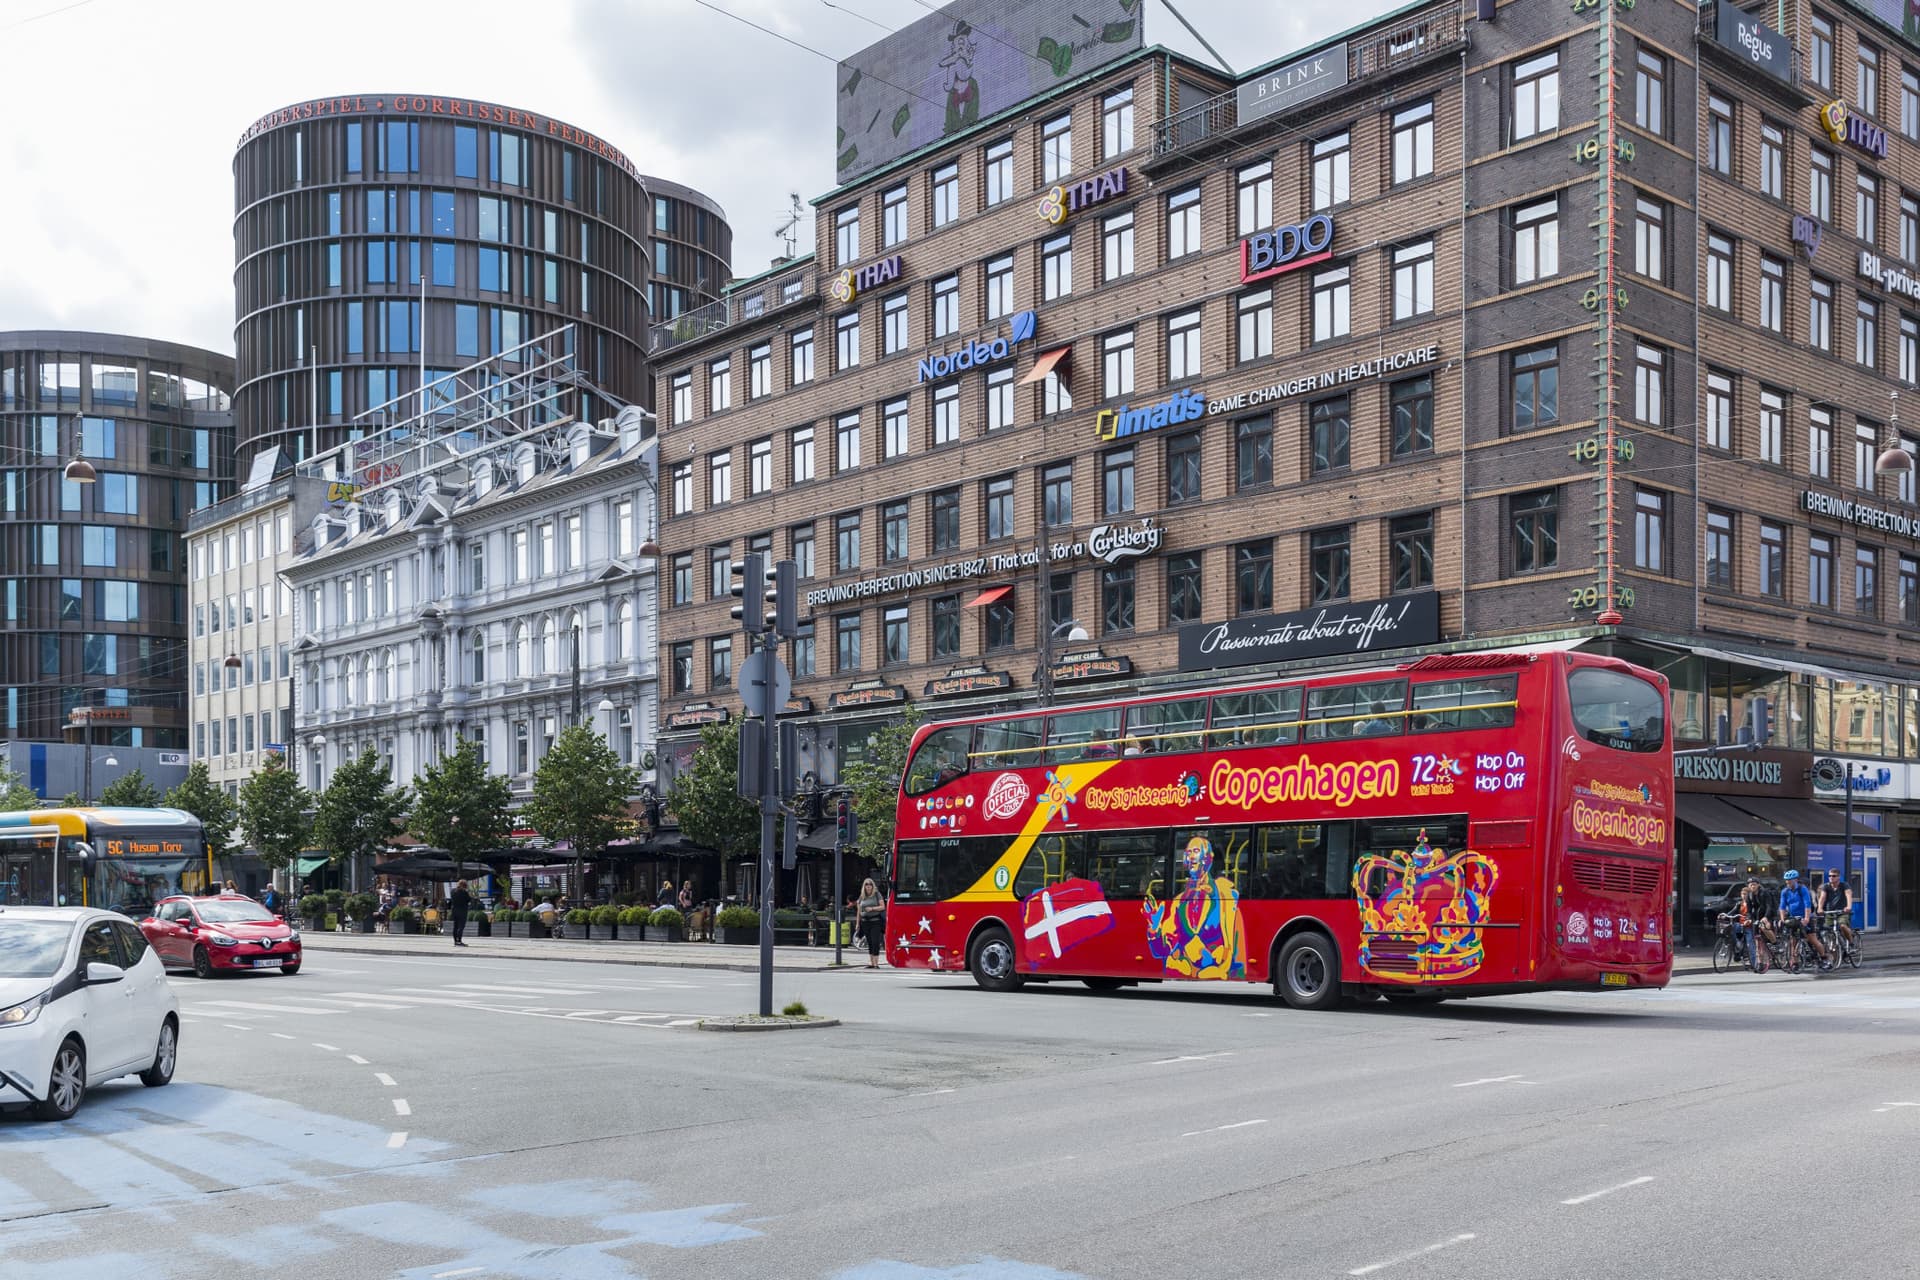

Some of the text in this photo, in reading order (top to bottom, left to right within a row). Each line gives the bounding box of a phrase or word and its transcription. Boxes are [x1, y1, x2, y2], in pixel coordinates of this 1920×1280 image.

[1738, 22, 1773, 62] Regus
[1257, 58, 1325, 98] BRINK
[254, 97, 367, 132] FEDERSPIEL
[393, 95, 537, 130] GORRISSEN
[1576, 138, 1599, 164] 10
[1848, 111, 1889, 158] THAI
[1066, 167, 1128, 211] THAI
[1250, 214, 1333, 271] BDO
[854, 255, 902, 292] THAI
[917, 337, 1009, 384] Nordea
[1207, 344, 1438, 416] GAME CHANGER IN HEALTHCARE
[1116, 388, 1206, 438] imatis
[1576, 438, 1598, 463] 10
[1807, 491, 1853, 520] BREWING
[1855, 504, 1911, 536] PERFECTION
[807, 583, 854, 606] BREWING
[855, 571, 922, 597] PERFECTION
[924, 565, 957, 585] SINCE
[991, 555, 1019, 571] That
[1051, 542, 1072, 560] for
[1074, 545, 1083, 555] a
[1089, 519, 1163, 563] Carlsberg
[1571, 587, 1599, 609] 20
[1200, 600, 1411, 654] Passionate about coffee!
[1208, 753, 1400, 810] Copenhagen
[1411, 755, 1436, 783] 72
[1476, 751, 1525, 772] Hop On
[1732, 759, 1782, 784] HOUSE
[1475, 772, 1526, 792] Hop Off
[1572, 799, 1665, 846] Copenhagen
[107, 840, 124, 855] 5C
[129, 841, 160, 854] Husum
[1567, 935, 1589, 944] MAN
